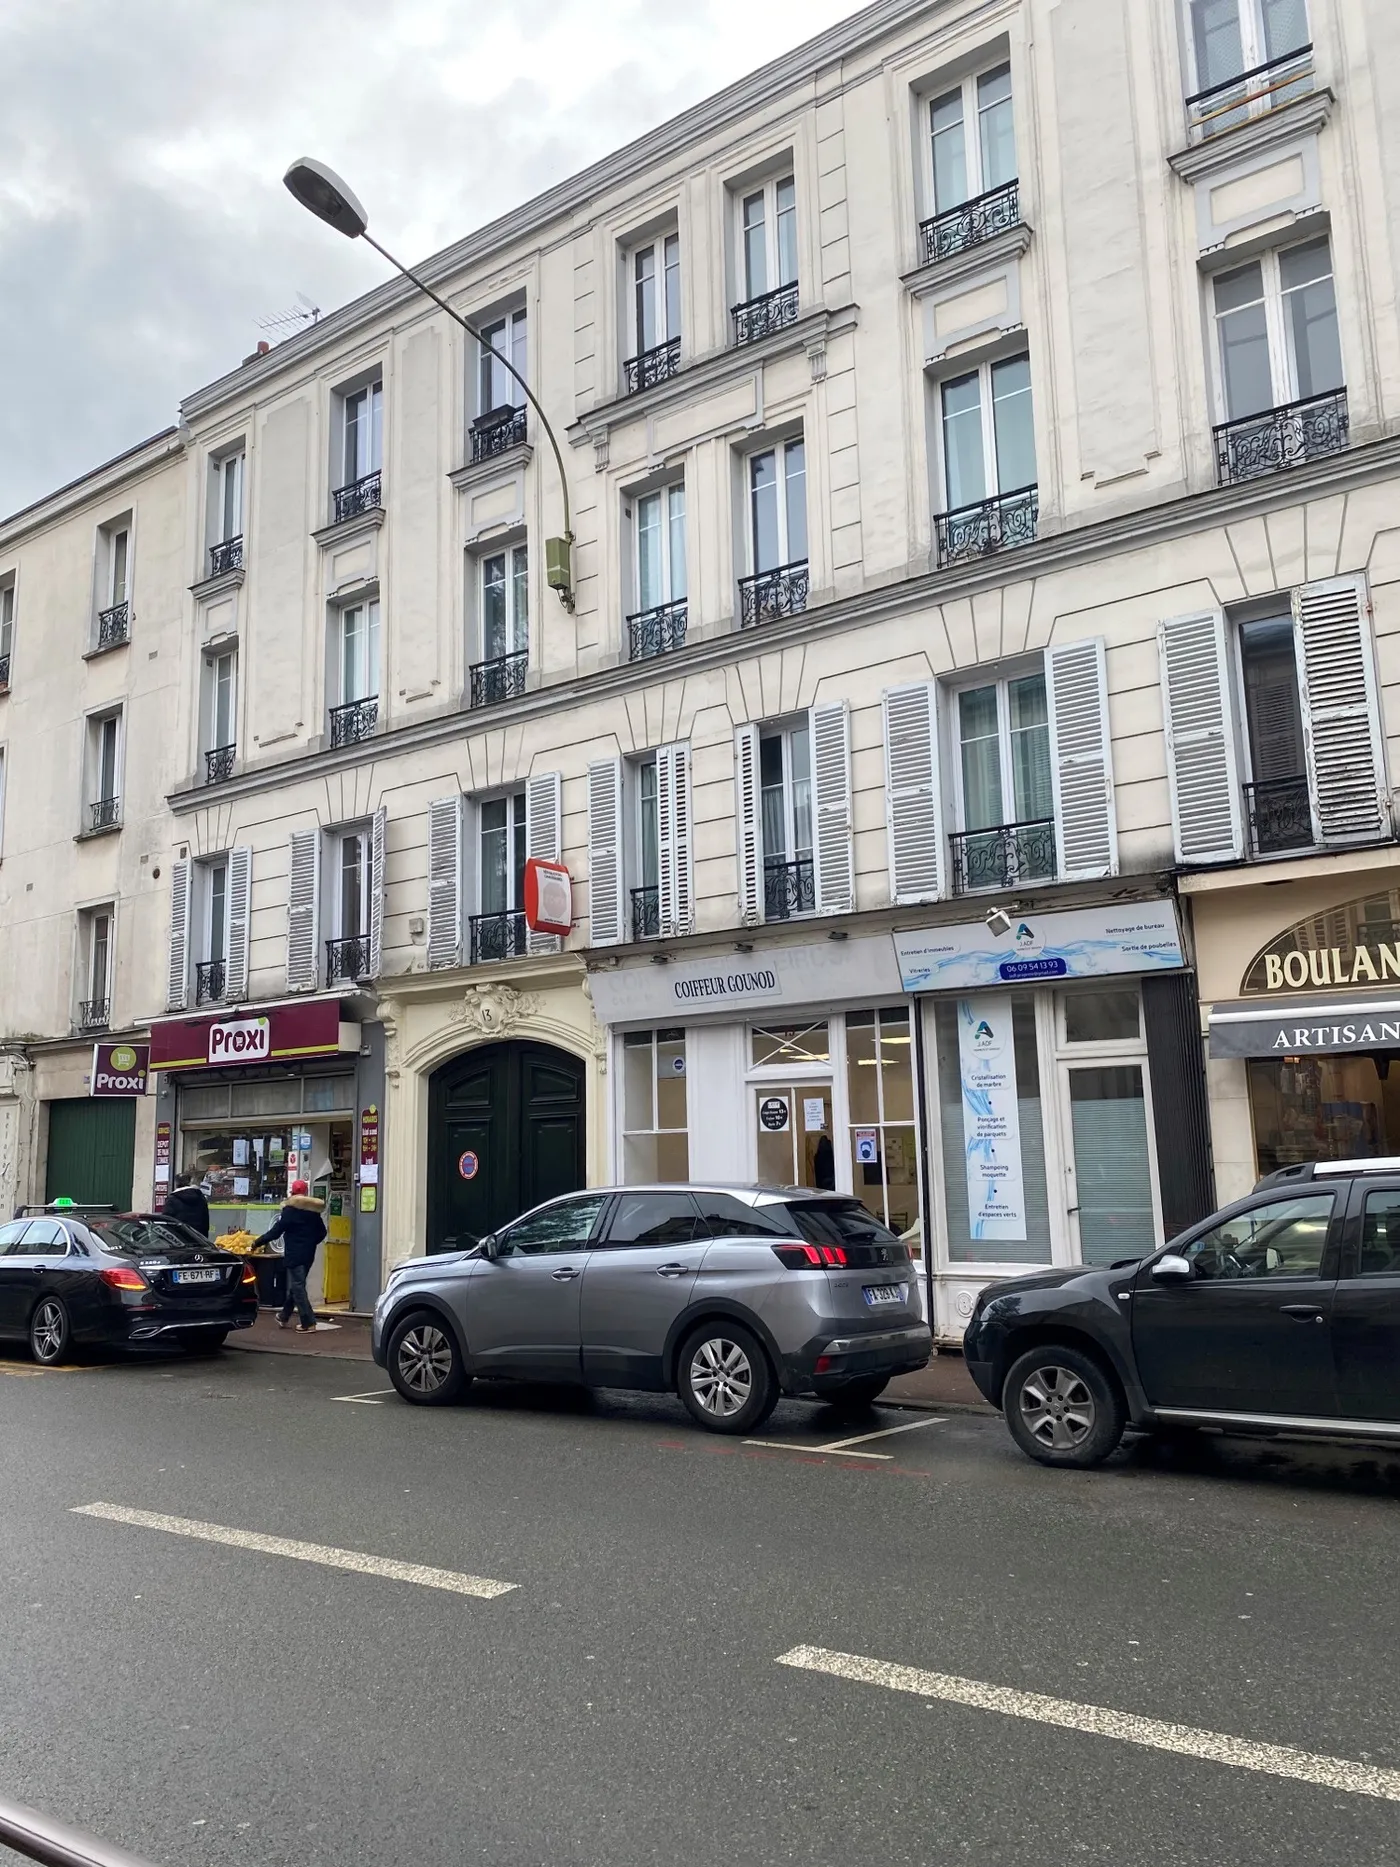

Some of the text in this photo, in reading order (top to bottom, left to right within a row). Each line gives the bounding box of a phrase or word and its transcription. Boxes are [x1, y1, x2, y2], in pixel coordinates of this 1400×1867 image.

[1106, 926, 1135, 934] Nettoyage
[900, 945, 954, 957] Entretien d'immeubles
[1148, 942, 1176, 951] poubelles
[1018, 963, 1028, 972] 09
[1028, 962, 1039, 970] 54
[1264, 941, 1400, 989] BOULAN
[674, 976, 727, 999] COIFFEUR
[728, 970, 775, 994] GOUNOD
[482, 1009, 492, 1022] 13
[212, 1017, 266, 1055] Proxi
[1272, 1022, 1400, 1048] ARTISAN
[96, 1070, 146, 1090] Proxi
